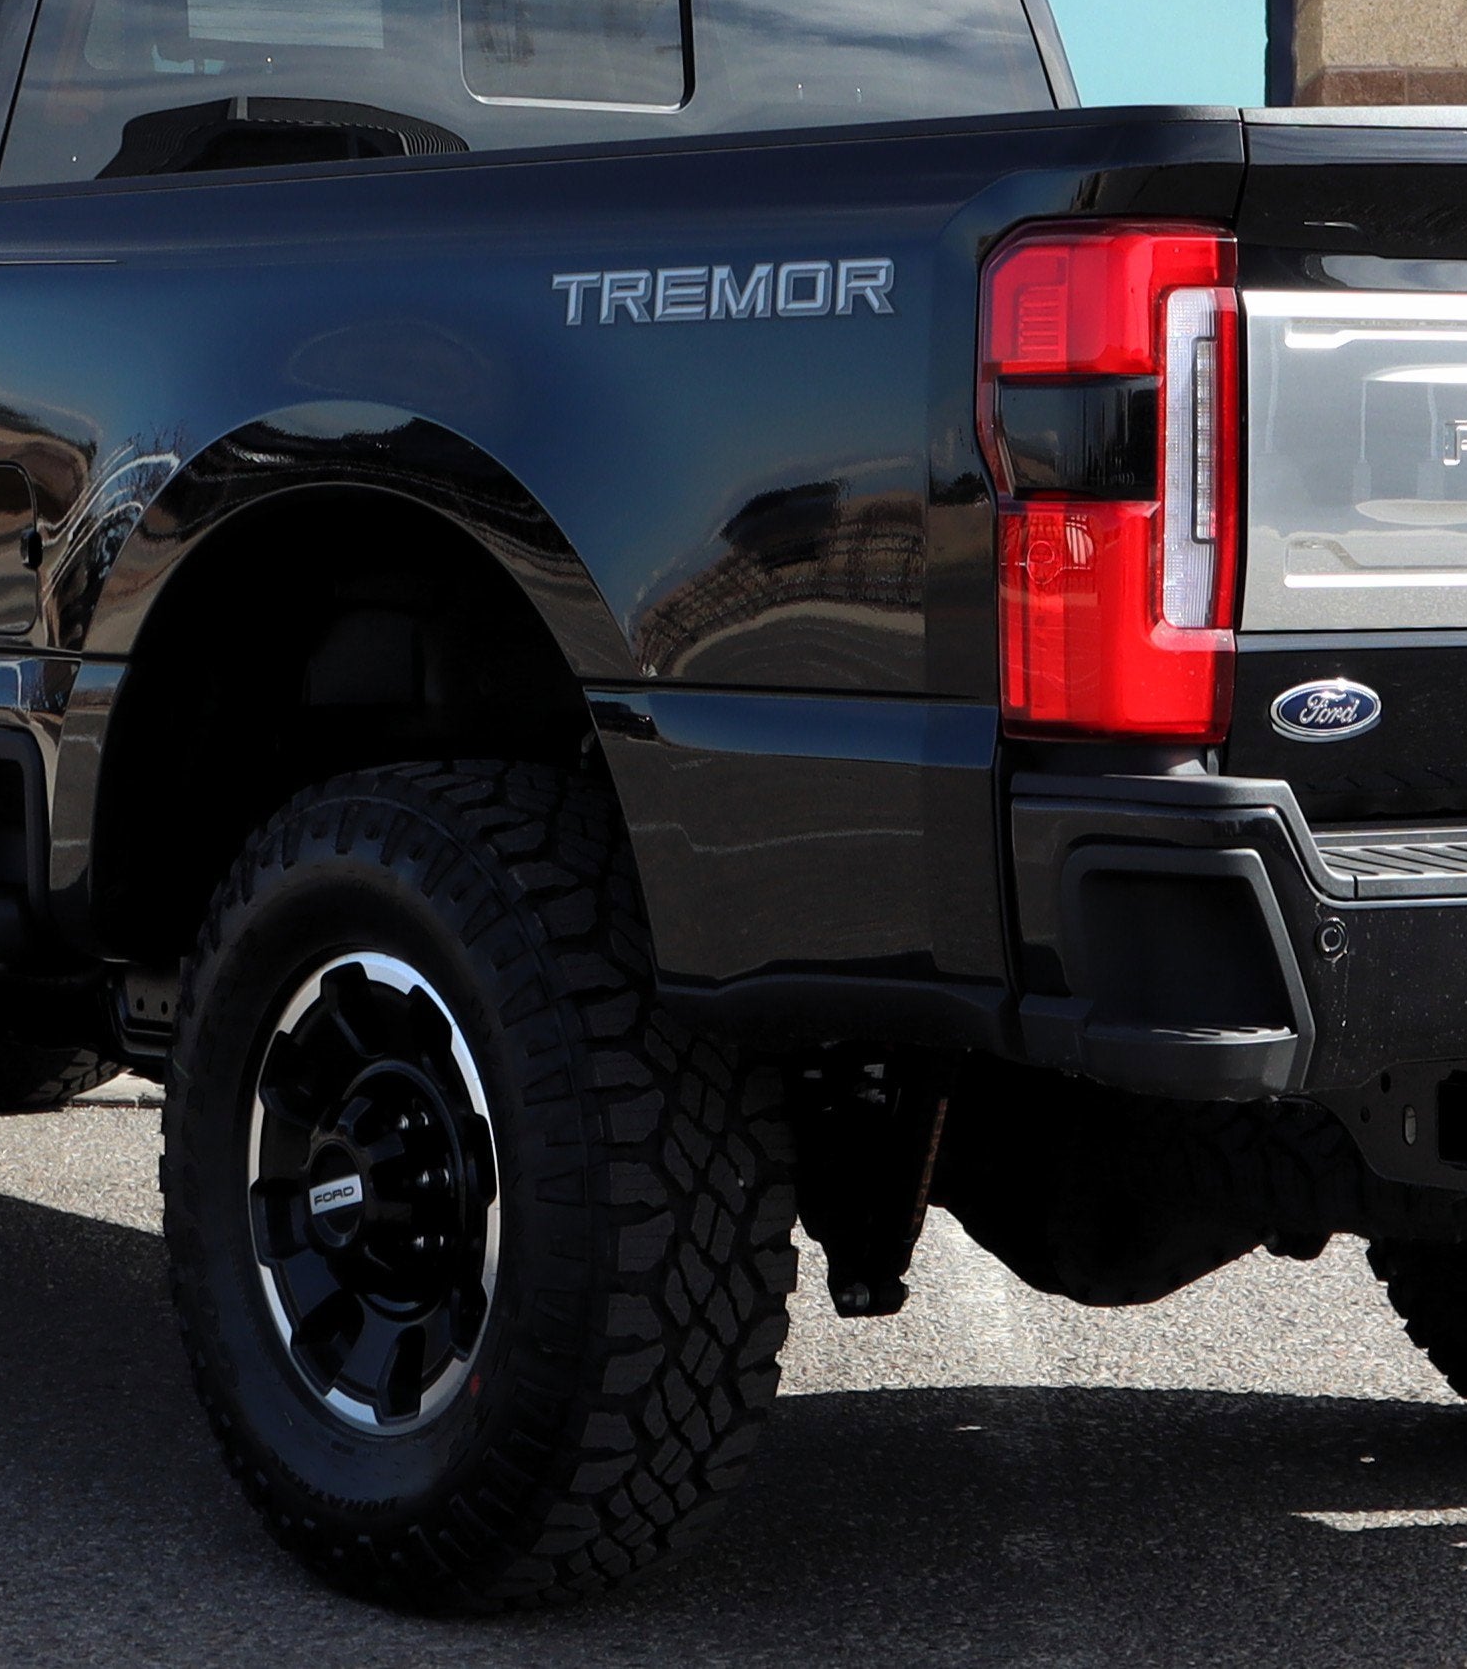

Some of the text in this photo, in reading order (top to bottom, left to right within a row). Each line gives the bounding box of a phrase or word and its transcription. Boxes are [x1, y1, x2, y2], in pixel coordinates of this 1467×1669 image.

[550, 256, 895, 326] TREMOR
[1298, 691, 1361, 725] Ford
[313, 1185, 355, 1206] FORD
